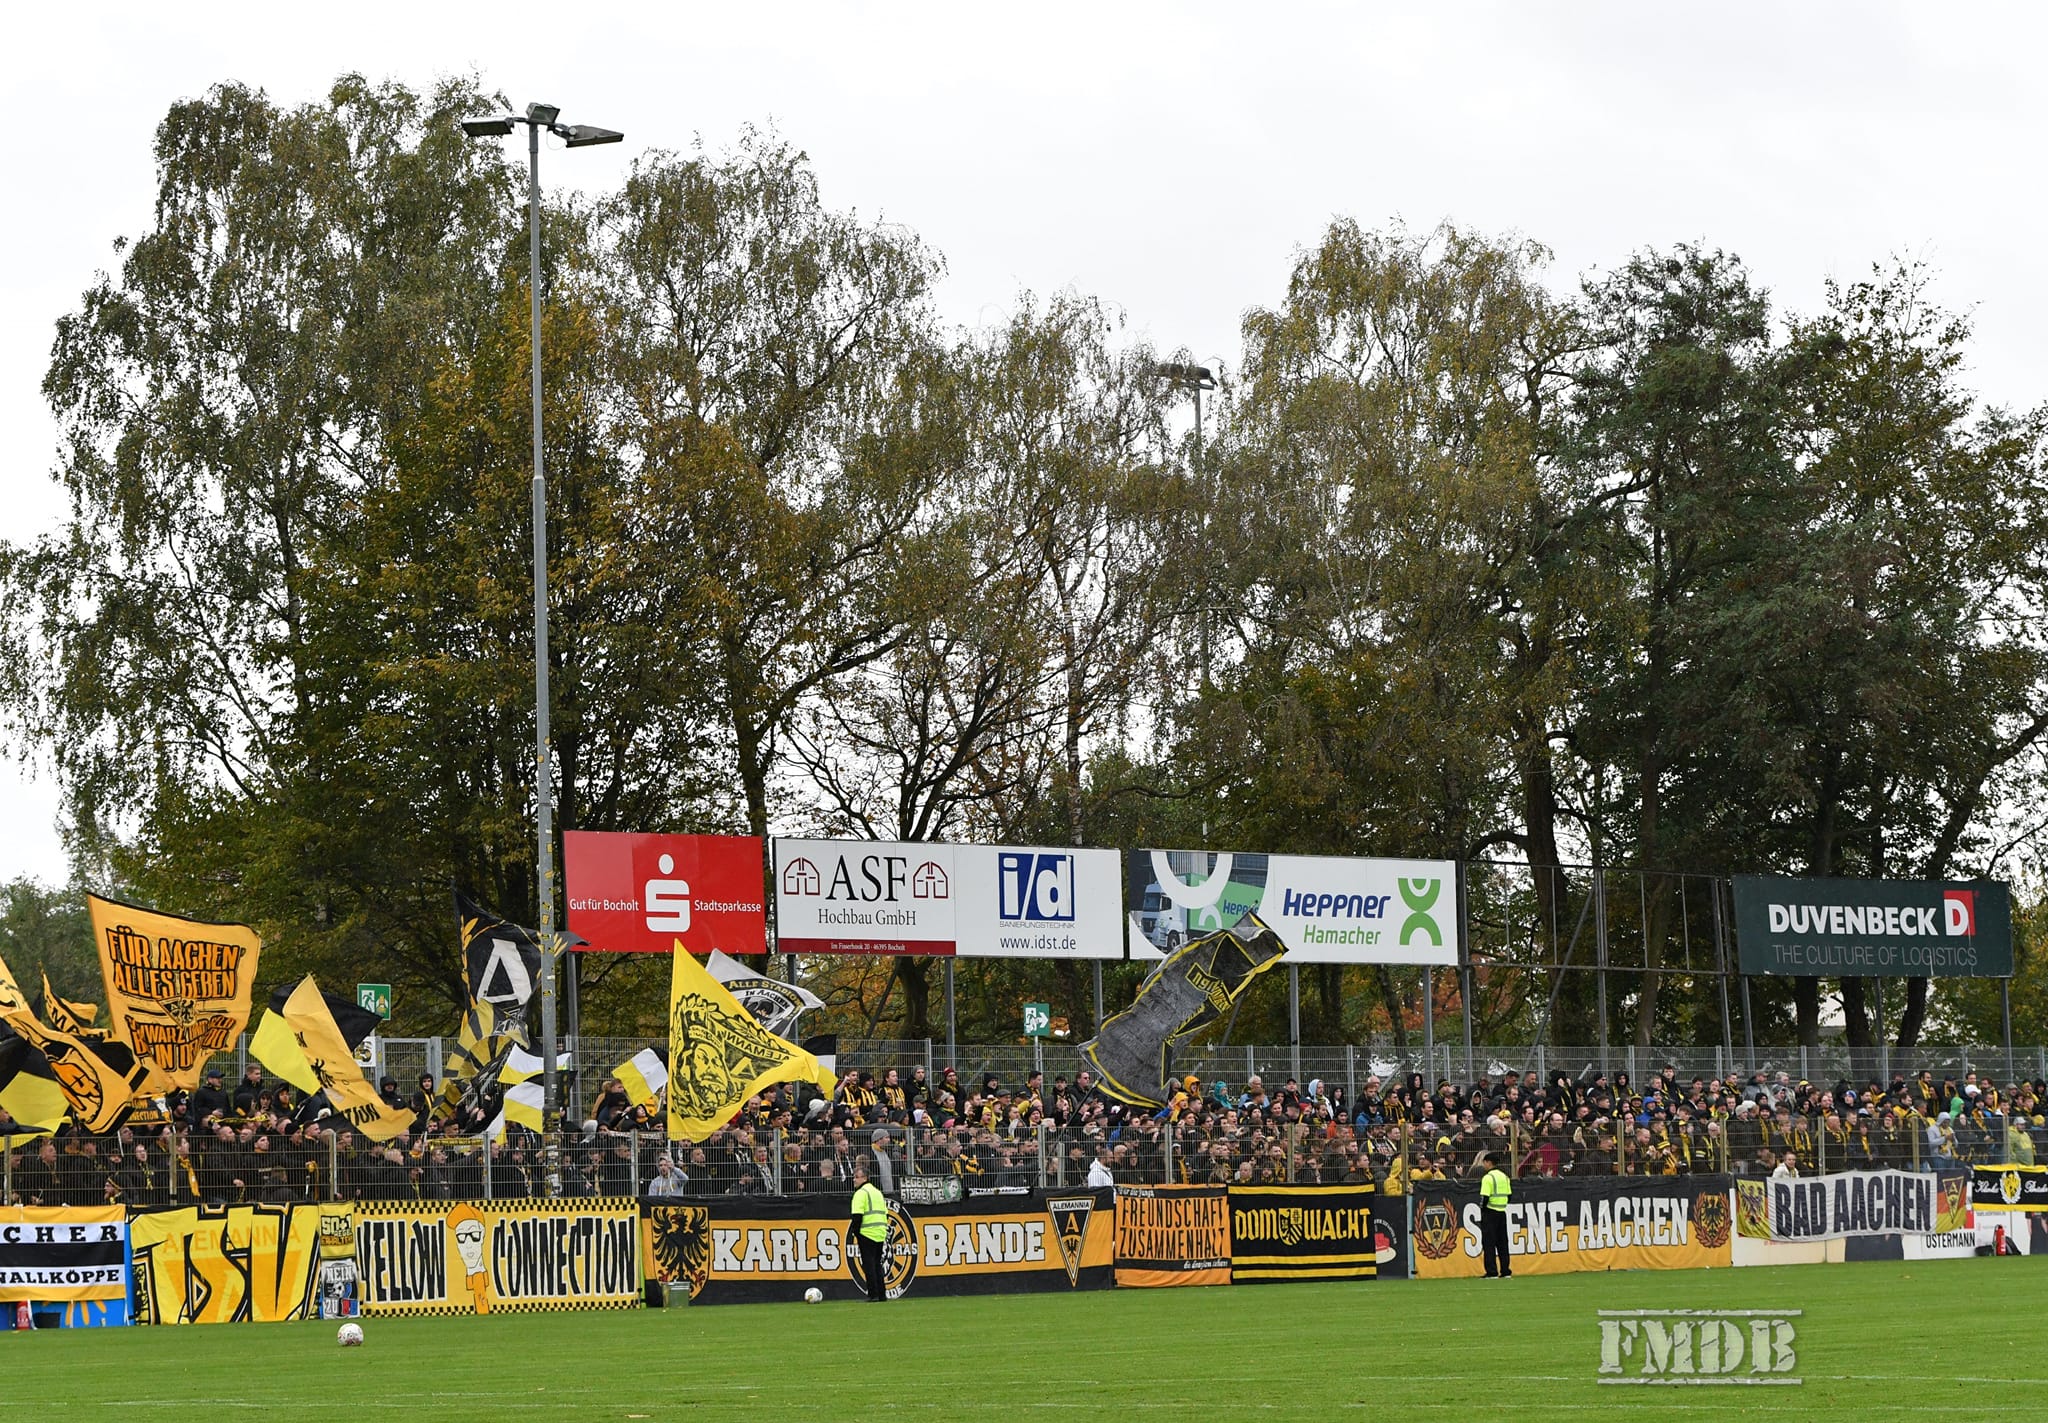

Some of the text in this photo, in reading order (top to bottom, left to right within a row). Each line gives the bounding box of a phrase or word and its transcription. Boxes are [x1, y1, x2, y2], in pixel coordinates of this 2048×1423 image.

[826, 855, 907, 902] ASF
[570, 899, 639, 911] Gut für Bocholt
[694, 900, 761, 914] Stadtsparkasse
[818, 909, 917, 926] Hochbau GmbH
[1768, 903, 1938, 936] DUVENBECK
[106, 925, 240, 971] FÜR AACHEN
[1000, 934, 1076, 950] www.idst.de
[1303, 924, 1381, 945] Hamacher
[1772, 944, 1977, 966] THE CULTURE OF LOGISTICS
[114, 962, 237, 1000] ALLES GEBEN
[1052, 1202, 1089, 1210] ALEMANNIA
[1122, 1197, 1223, 1228] FREUNDSCHAFT
[1775, 1175, 1932, 1237] BAD AACHEN
[164, 1218, 301, 1254] ALEMANNA
[1065, 1212, 1080, 1233] A
[1235, 1208, 1279, 1241] DOM
[1303, 1208, 1371, 1240] WACHT
[1463, 1200, 1569, 1258] SENE
[1578, 1196, 1690, 1251] AACHEN
[712, 1228, 840, 1272] KARLS
[924, 1221, 1046, 1267] BANDE
[1119, 1227, 1225, 1259] ZUSAMMENHALT
[1926, 1232, 1976, 1249] OSTERMANN
[356, 1215, 636, 1303] YELLOW CONNECTION
